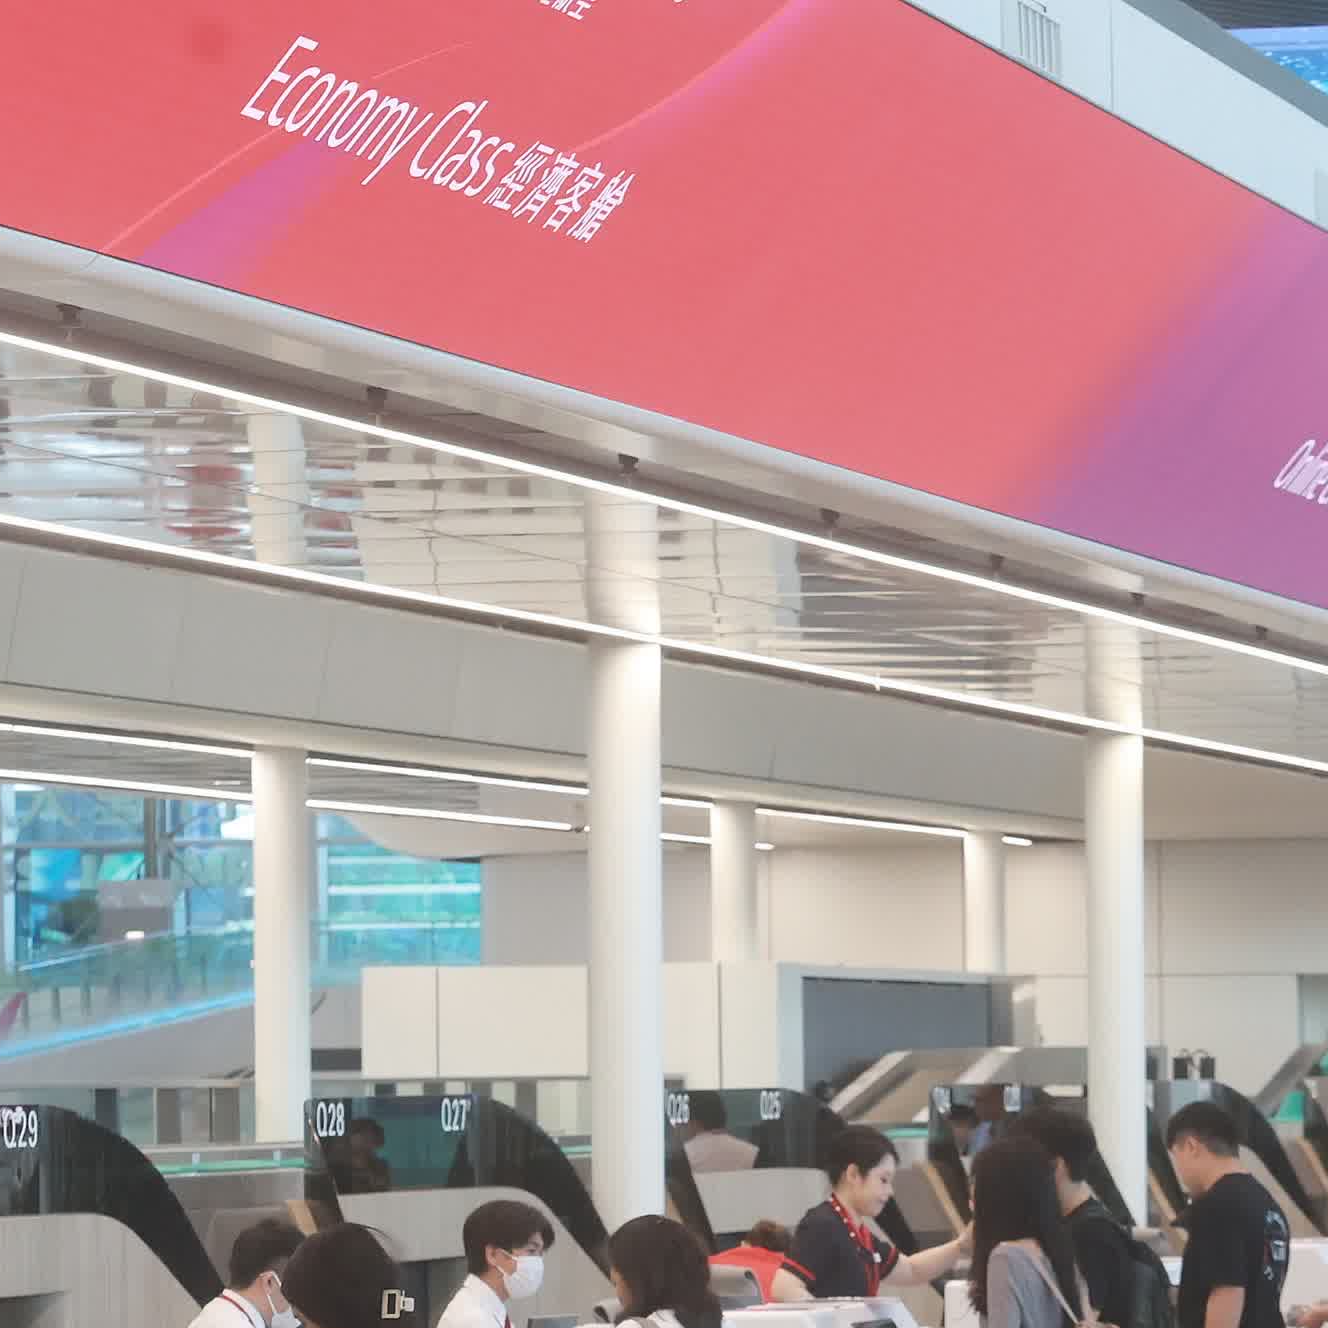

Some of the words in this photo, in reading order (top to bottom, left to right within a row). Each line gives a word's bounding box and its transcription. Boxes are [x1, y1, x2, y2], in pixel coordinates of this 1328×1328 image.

[240, 35, 433, 186] Economy
[409, 100, 515, 197] Class
[483, 141, 635, 243] 經濟客艙
[3, 1109, 38, 1149] Q29
[316, 1102, 345, 1137] Q28
[441, 1097, 467, 1132] Q27
